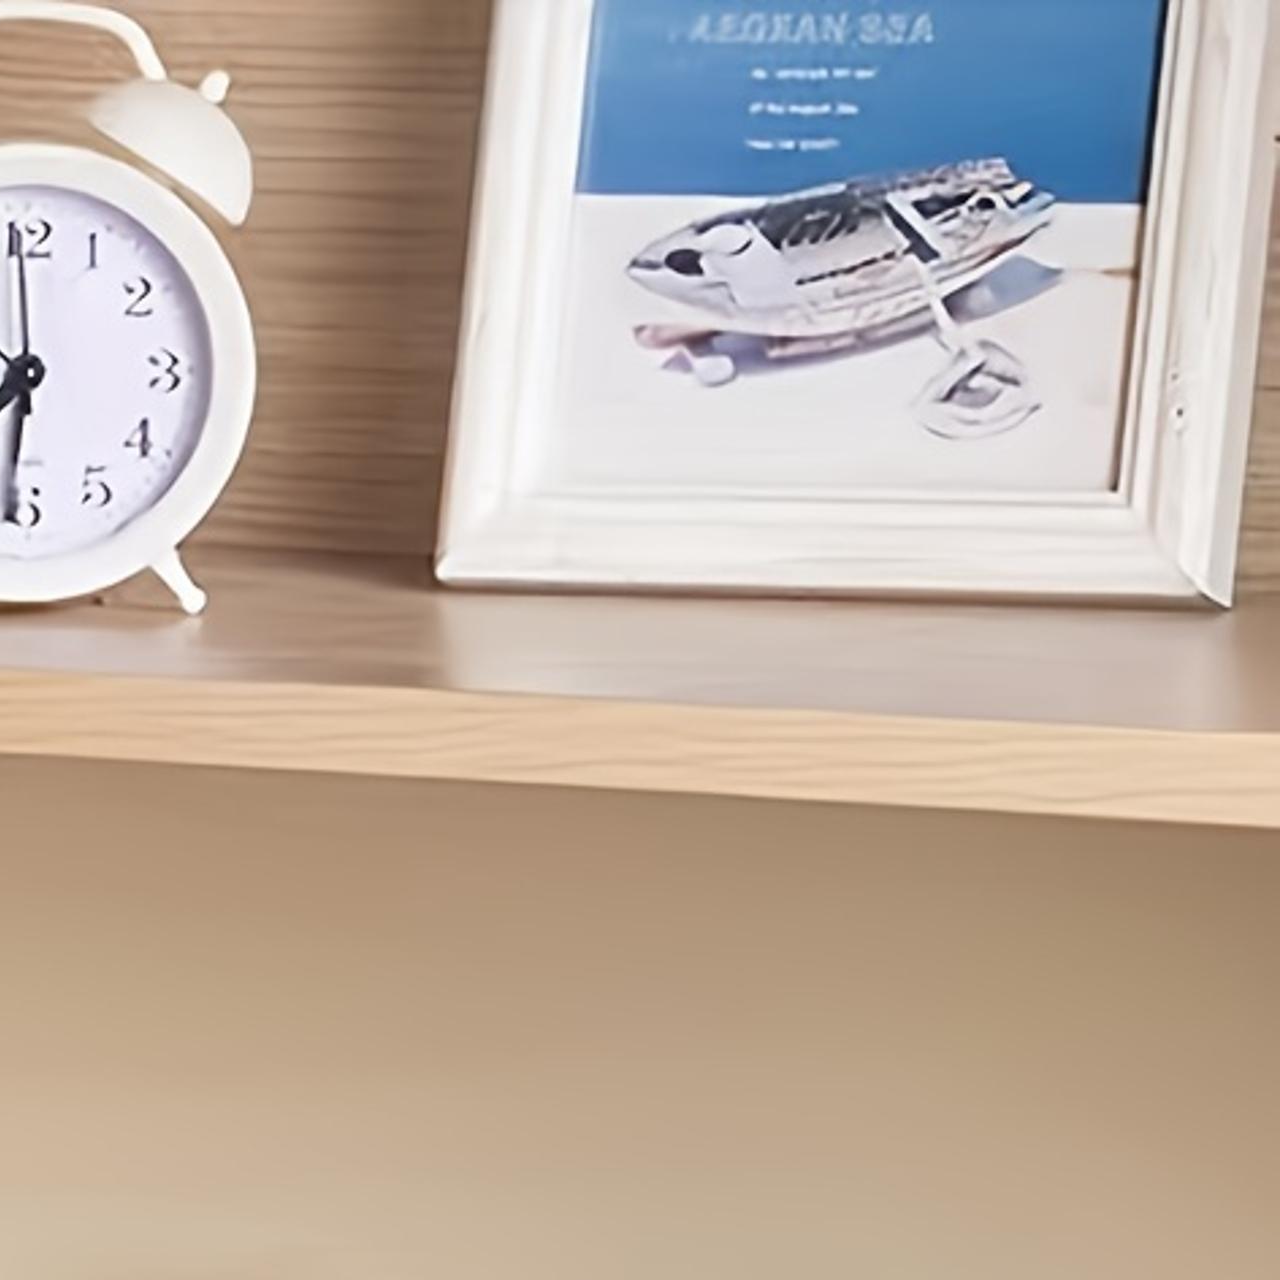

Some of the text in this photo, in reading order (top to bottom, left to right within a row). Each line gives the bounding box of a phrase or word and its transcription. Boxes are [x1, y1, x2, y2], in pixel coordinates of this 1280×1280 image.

[7, 219, 53, 259] 12
[87, 231, 98, 270] 1
[122, 275, 154, 318] 2
[147, 347, 182, 394] 3
[123, 417, 153, 459] 4
[81, 465, 113, 508] 5
